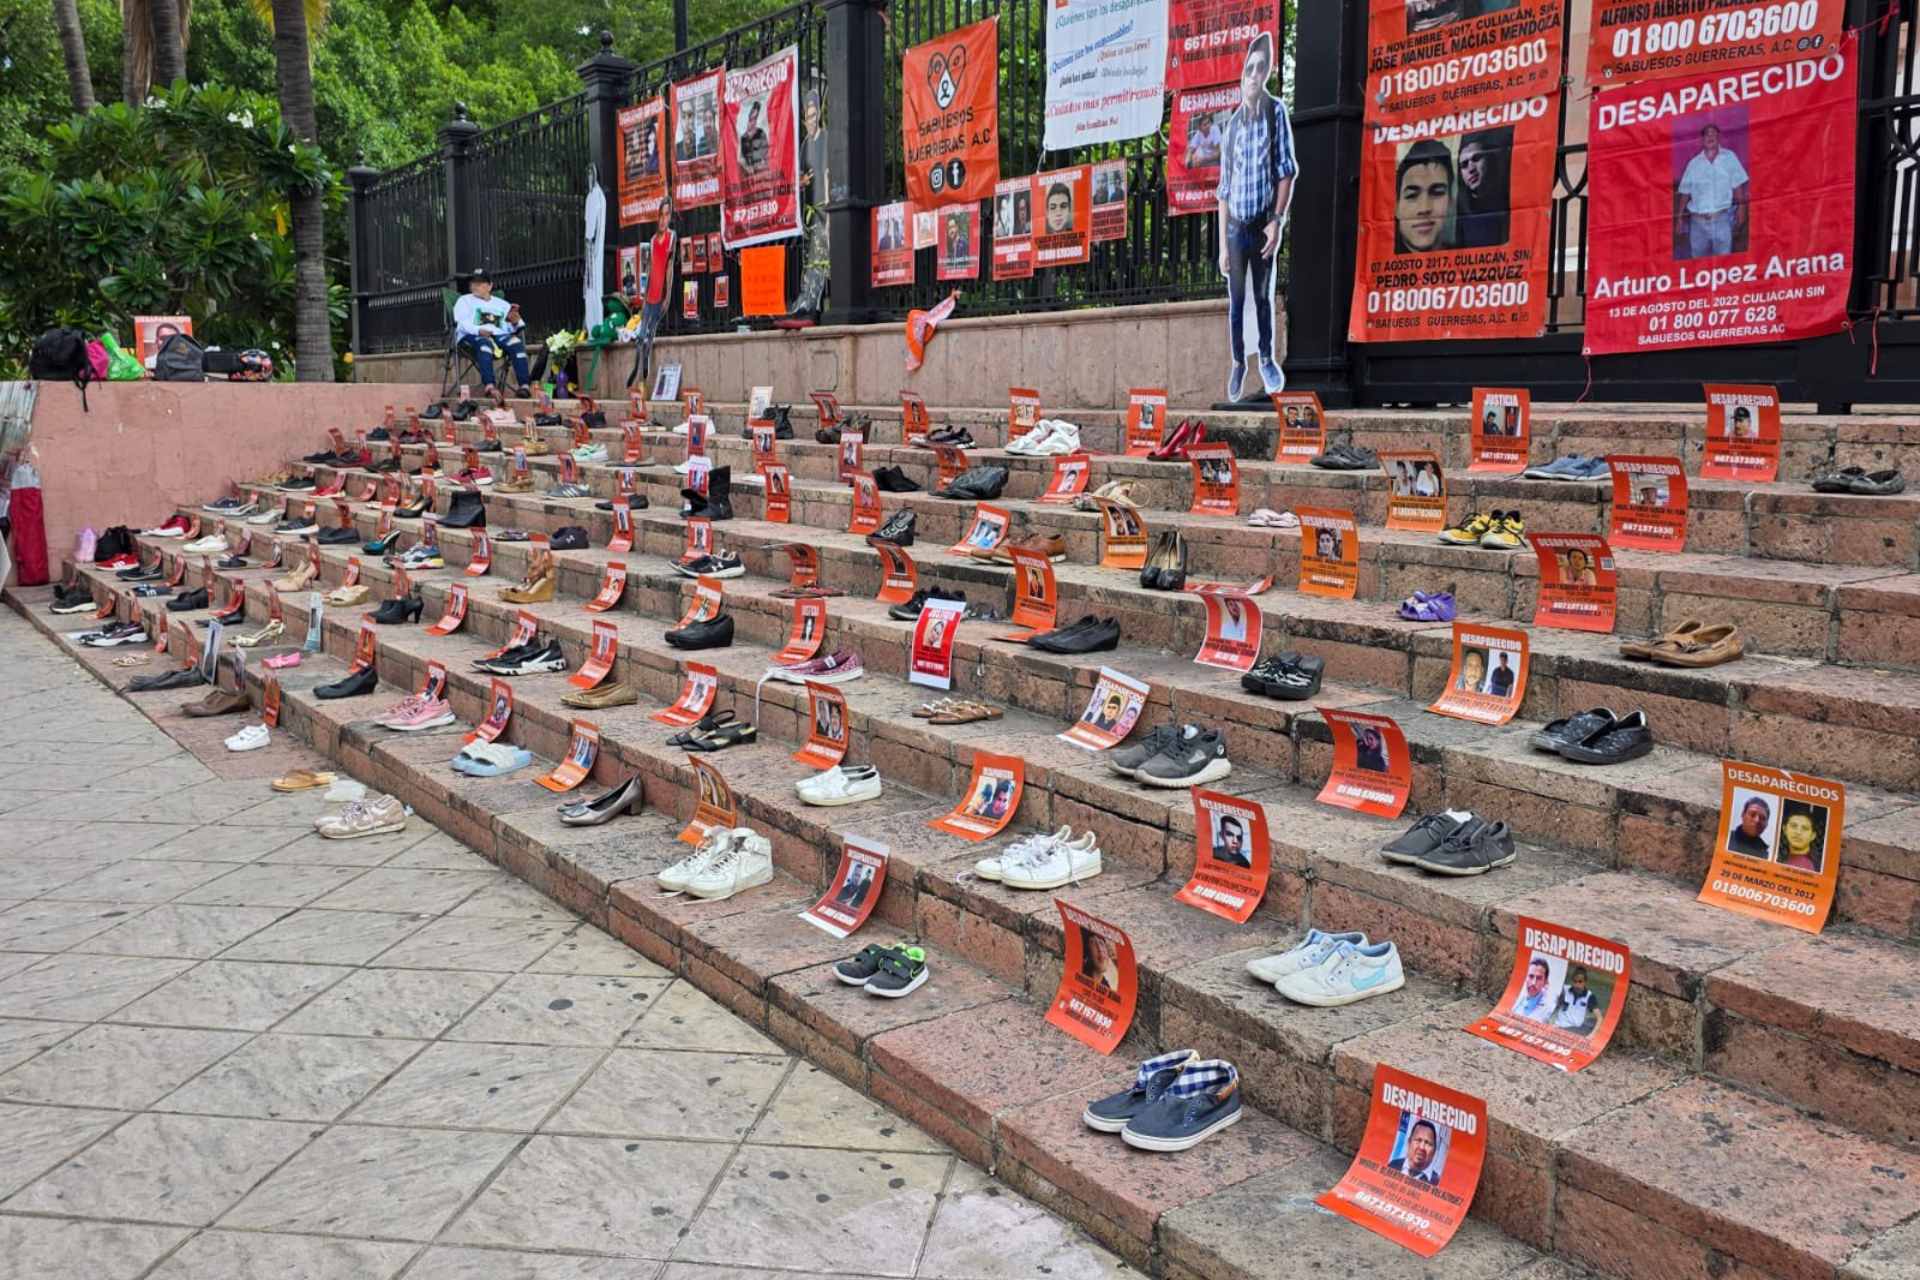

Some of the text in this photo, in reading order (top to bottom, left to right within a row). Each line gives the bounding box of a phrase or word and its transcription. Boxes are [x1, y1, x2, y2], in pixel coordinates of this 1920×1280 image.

[1601, 4, 1650, 27] ALFONSO
[1612, 0, 1818, 58] 01 800 6703600
[1184, 24, 1259, 51] 667 157 1930
[1370, 56, 1397, 72] JOSE
[1402, 43, 1447, 64] MANUEL
[1500, 14, 1560, 40] MENDOZA
[1380, 38, 1547, 98] 018006703600
[1616, 55, 1681, 73] SABUESOS
[1389, 94, 1436, 112] SABUESOS
[1599, 54, 1845, 130] DESAPARECIDO
[919, 106, 974, 136] SABUESOS
[1374, 95, 1548, 145] DESAPARECIDO
[1377, 265, 1523, 288] PEDRO SOTO VAZQUEZ
[1384, 258, 1423, 272] AGOSTO
[1594, 252, 1845, 298] Arturo Lopez Arana
[1368, 281, 1529, 313] 018006703600
[1609, 286, 1825, 317] 13 DE AGOSTO DEL 2022 CULIACAN SIN
[1375, 316, 1420, 328] SABUESOS
[1638, 324, 1785, 345] SABUESOS GUERRERAS AC
[1649, 306, 1776, 332] 01 800 077 628
[1728, 768, 1840, 802] DESAPARECIDOS
[1712, 879, 1816, 916] 018006703600
[1732, 873, 1742, 881] DE
[1744, 875, 1776, 892] MARZO
[1777, 883, 1792, 895] DEL
[1524, 927, 1625, 974] DESAPARECIDO
[1382, 1082, 1477, 1136] DESAPARECIDO
